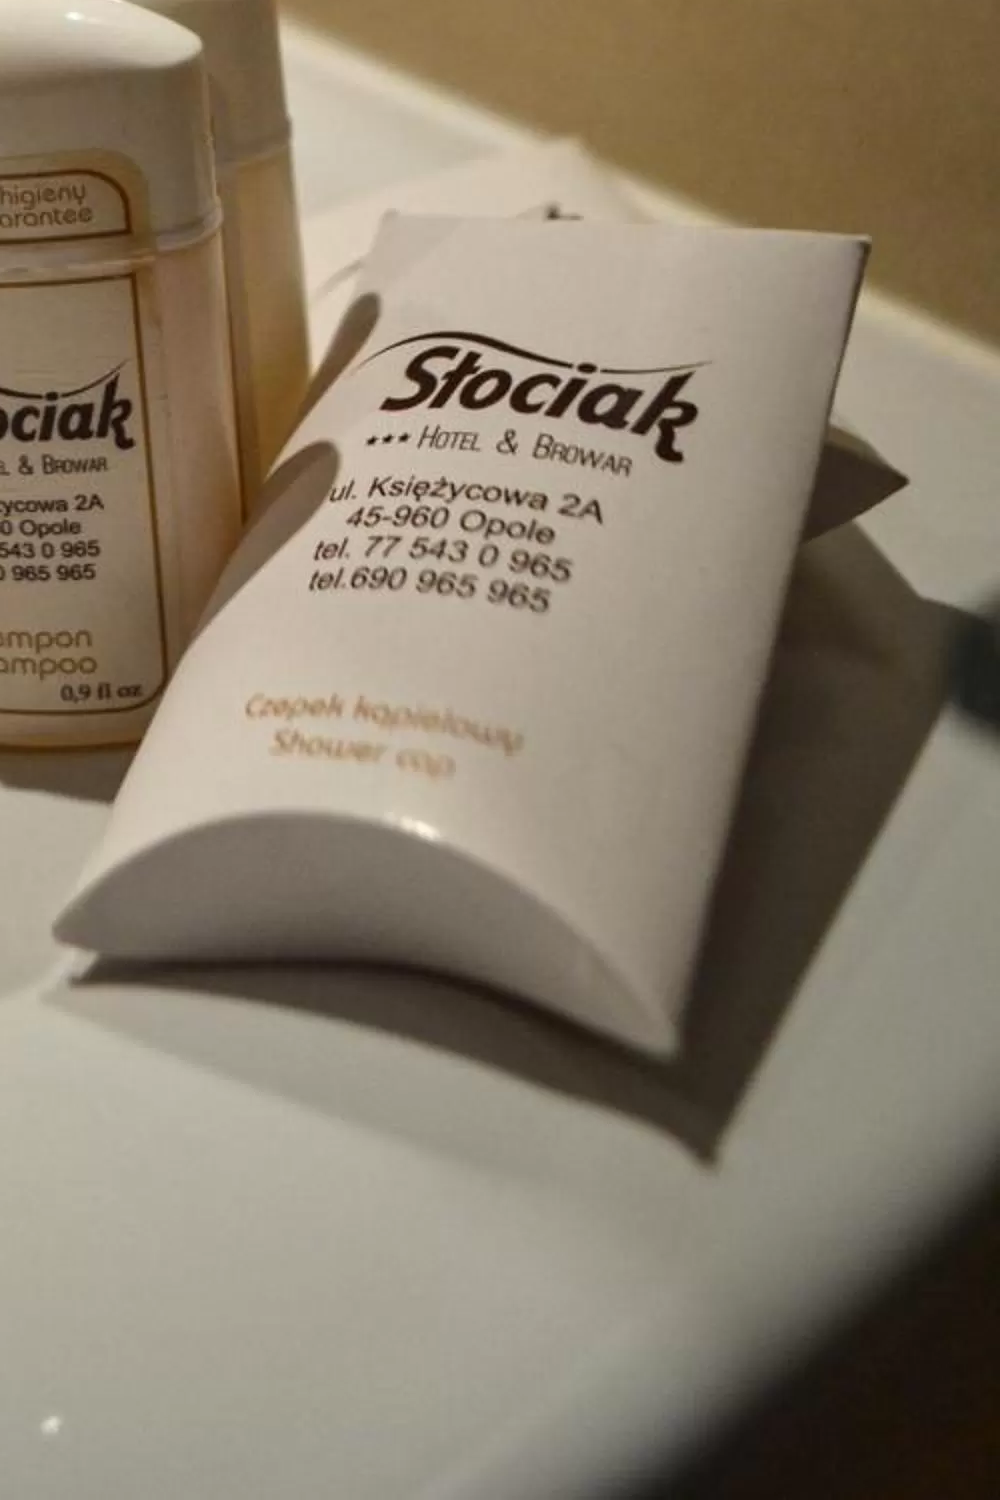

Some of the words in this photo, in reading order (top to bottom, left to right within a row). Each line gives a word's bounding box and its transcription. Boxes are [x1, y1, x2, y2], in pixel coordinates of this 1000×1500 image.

[0, 183, 87, 210] higieny
[496, 428, 520, 455] &
[18, 454, 34, 476] &
[74, 494, 105, 511] 2A
[557, 493, 604, 525] 2A
[19, 518, 81, 539] Opole
[345, 505, 450, 530] 45-960
[459, 508, 557, 547] Opole
[56, 562, 98, 581] 965
[312, 537, 351, 562] tel.
[364, 535, 403, 558] 77
[408, 536, 469, 563] 543
[478, 544, 500, 569] 0
[508, 550, 574, 584] 965
[415, 568, 477, 599] 965
[486, 578, 552, 614] 965
